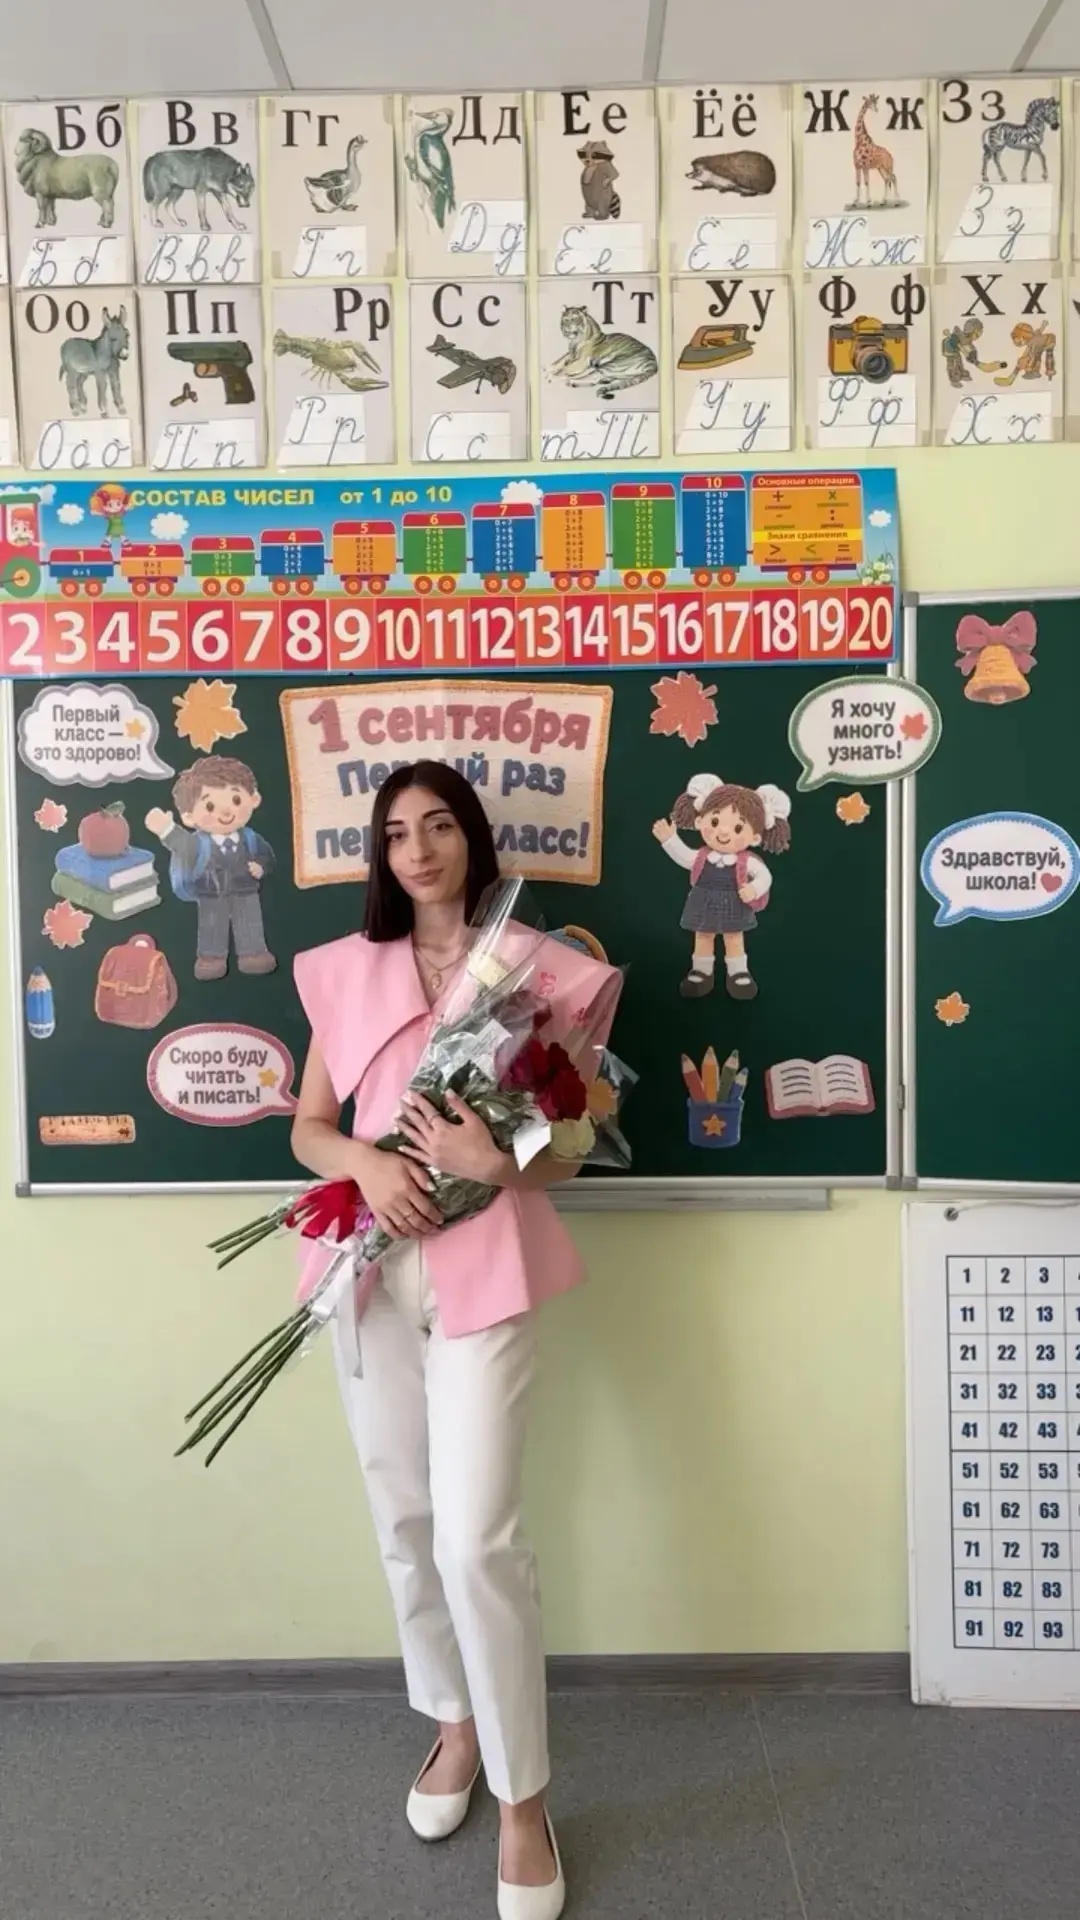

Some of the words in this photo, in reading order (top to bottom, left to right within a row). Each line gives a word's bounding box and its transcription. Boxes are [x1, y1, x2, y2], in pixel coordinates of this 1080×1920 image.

[706, 477, 722, 488] 10
[758, 477, 805, 486] Основные
[807, 476, 855, 487] операции
[131, 489, 226, 506] СОСТАВ
[234, 489, 315, 506] ЧИСЕЛ
[340, 491, 364, 504] от
[372, 488, 382, 503] 1
[391, 490, 418, 506] до
[426, 486, 452, 503] 10
[639, 485, 648, 496] 9
[569, 494, 578, 505] 8
[499, 505, 508, 516] 7
[430, 514, 439, 525] 6
[360, 523, 368, 534] 5
[768, 532, 795, 540] Знаки
[797, 531, 848, 541] сравнения
[219, 538, 227, 549] 3
[288, 532, 297, 543] 4
[78, 551, 84, 562] 1
[149, 545, 157, 556] 2
[8, 613, 43, 666] 2
[54, 611, 87, 664] 3
[97, 611, 135, 663] 4
[147, 610, 181, 662] 5
[192, 609, 229, 662] 6
[240, 611, 274, 662] 7
[286, 608, 323, 662] 8
[334, 608, 370, 661] 9
[378, 608, 420, 661] 10
[426, 608, 465, 659] 11
[472, 607, 516, 659] 12
[518, 605, 561, 657] 13
[565, 605, 608, 657] 14
[612, 603, 655, 656] 15
[659, 601, 703, 655] 16
[706, 602, 750, 654] 17
[753, 598, 797, 653] 18
[801, 597, 845, 651] 19
[848, 596, 893, 651] 20
[52, 704, 120, 726] Первый
[832, 699, 843, 717] Я
[850, 701, 896, 721] хочу
[308, 698, 350, 752] 1
[358, 697, 591, 754] сентября
[834, 723, 894, 739] много
[55, 728, 104, 741] класс
[34, 747, 61, 761] это
[65, 745, 141, 764] здорово!
[828, 740, 902, 765] узнать!
[337, 752, 489, 797] Пей
[502, 758, 566, 796] раз
[492, 821, 590, 859] ласс!
[941, 847, 1066, 870] Здравствуй,
[966, 872, 1036, 890] школа!
[169, 1047, 222, 1067] Скоро
[227, 1047, 268, 1067] буду
[186, 1069, 245, 1084] читать
[178, 1092, 188, 1104] и
[194, 1086, 261, 1105] писать!
[963, 1267, 970, 1283] 1
[1000, 1267, 1010, 1283] 2
[1039, 1267, 1049, 1283] 3
[960, 1306, 975, 1322] 11
[998, 1306, 1014, 1322] 12
[1036, 1306, 1053, 1322] 13
[960, 1345, 976, 1361] 21
[997, 1345, 1016, 1361] 22
[1036, 1345, 1055, 1361] 23
[960, 1383, 978, 1399] 31
[998, 1383, 1017, 1399] 32
[1036, 1383, 1056, 1399] 33
[961, 1422, 978, 1438] 41
[999, 1422, 1018, 1438] 42
[1037, 1422, 1057, 1438] 43
[962, 1462, 979, 1479] 51
[999, 1462, 1019, 1480] 52
[1038, 1463, 1058, 1480] 53
[963, 1502, 980, 1518] 61
[1001, 1502, 1020, 1519] 62
[1039, 1503, 1059, 1519] 63
[964, 1541, 980, 1558] 71
[1002, 1541, 1020, 1559] 72
[1041, 1542, 1059, 1559] 73
[964, 1581, 982, 1597] 81
[1002, 1581, 1022, 1598] 82
[1041, 1582, 1062, 1598] 83
[965, 1620, 983, 1637] 91
[1003, 1620, 1023, 1638] 92
[1042, 1621, 1063, 1638] 93
